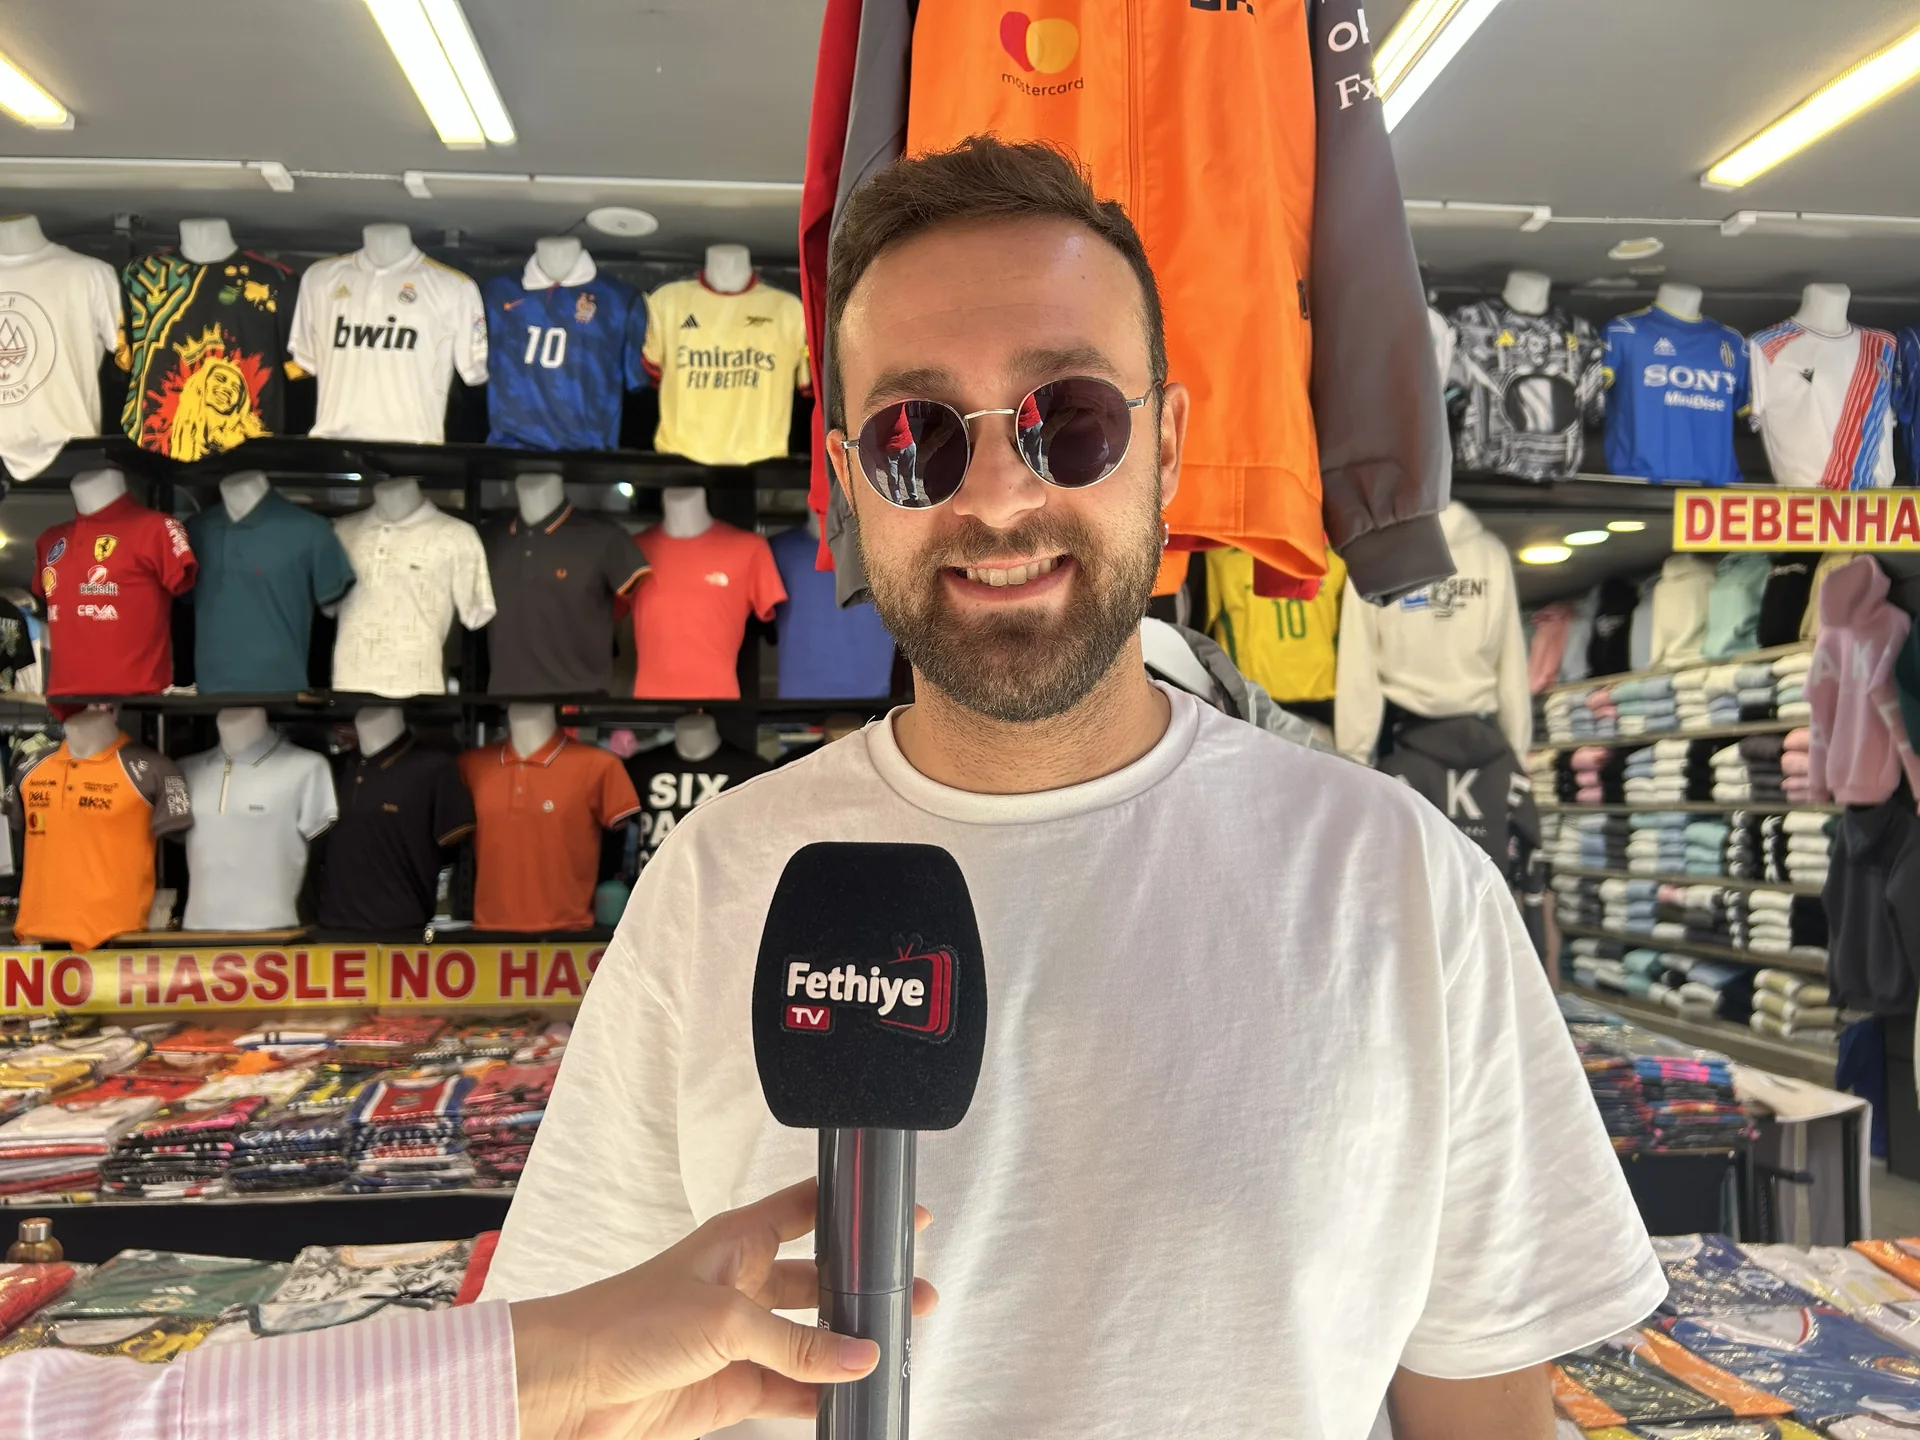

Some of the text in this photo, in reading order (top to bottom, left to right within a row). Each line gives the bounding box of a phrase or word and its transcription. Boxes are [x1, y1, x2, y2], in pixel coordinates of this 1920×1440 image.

[1001, 73, 1084, 96] mastercard
[333, 315, 418, 350] bwin
[524, 325, 567, 369] 10
[677, 344, 776, 372] Emirates
[687, 368, 759, 389] FLY BETTER
[1643, 364, 1736, 395] SONY
[1272, 598, 1307, 640] 10
[648, 772, 730, 809] SIX
[4, 951, 367, 1008] NO HASSLE
[389, 949, 477, 1000] NO
[786, 961, 925, 1016] Fethiye
[791, 1007, 825, 1025] TV
